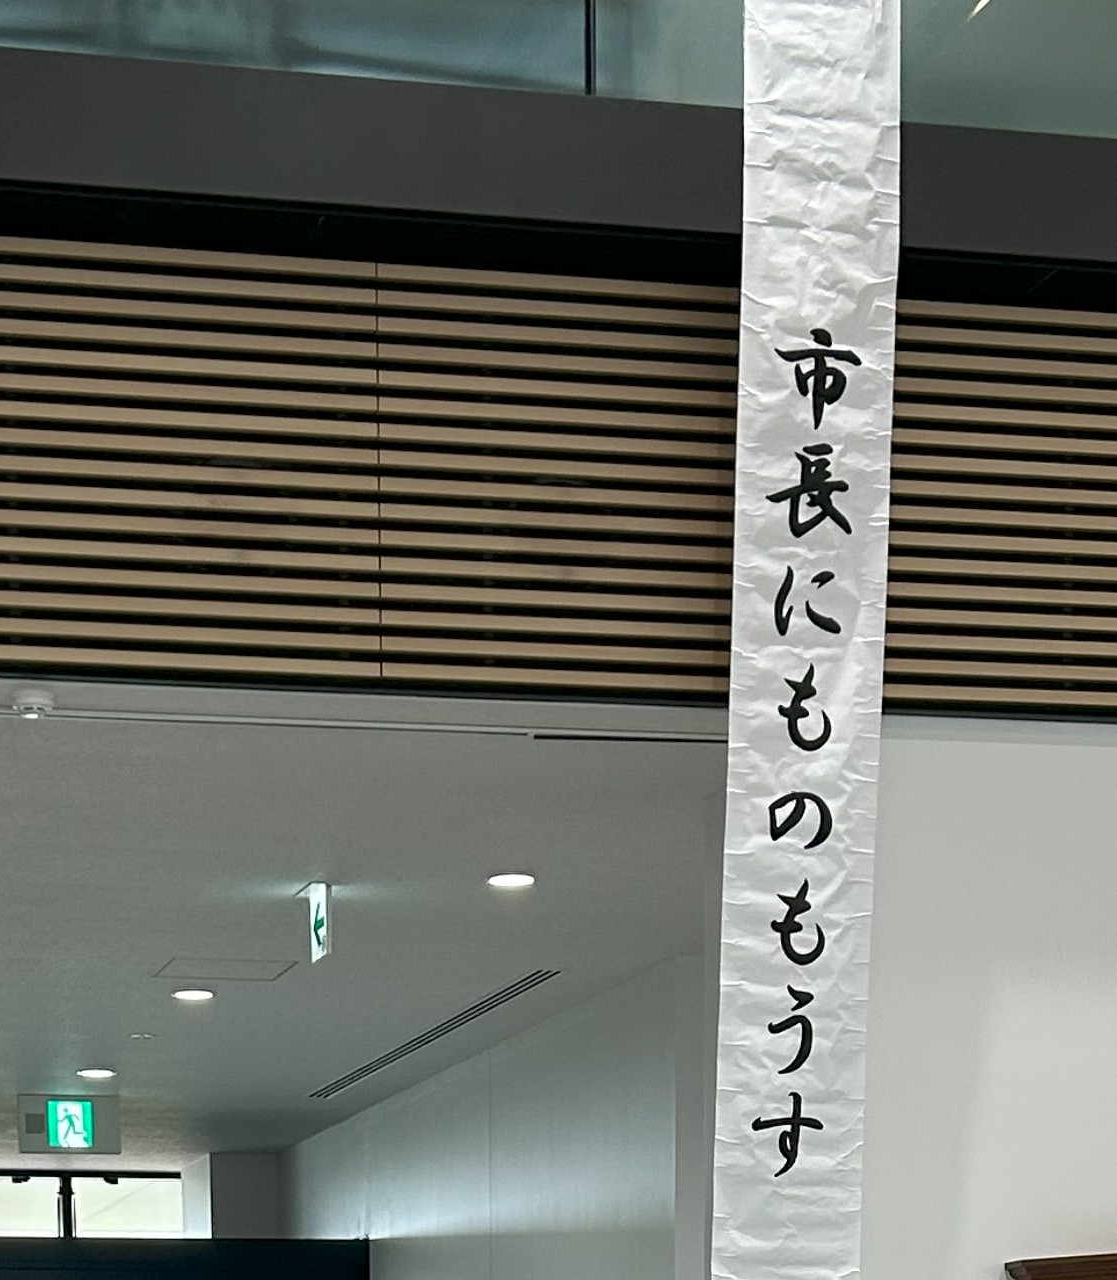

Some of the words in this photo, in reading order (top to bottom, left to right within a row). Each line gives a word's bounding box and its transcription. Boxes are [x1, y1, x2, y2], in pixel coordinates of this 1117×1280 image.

[751, 327, 863, 1178] 市長にものもうす
